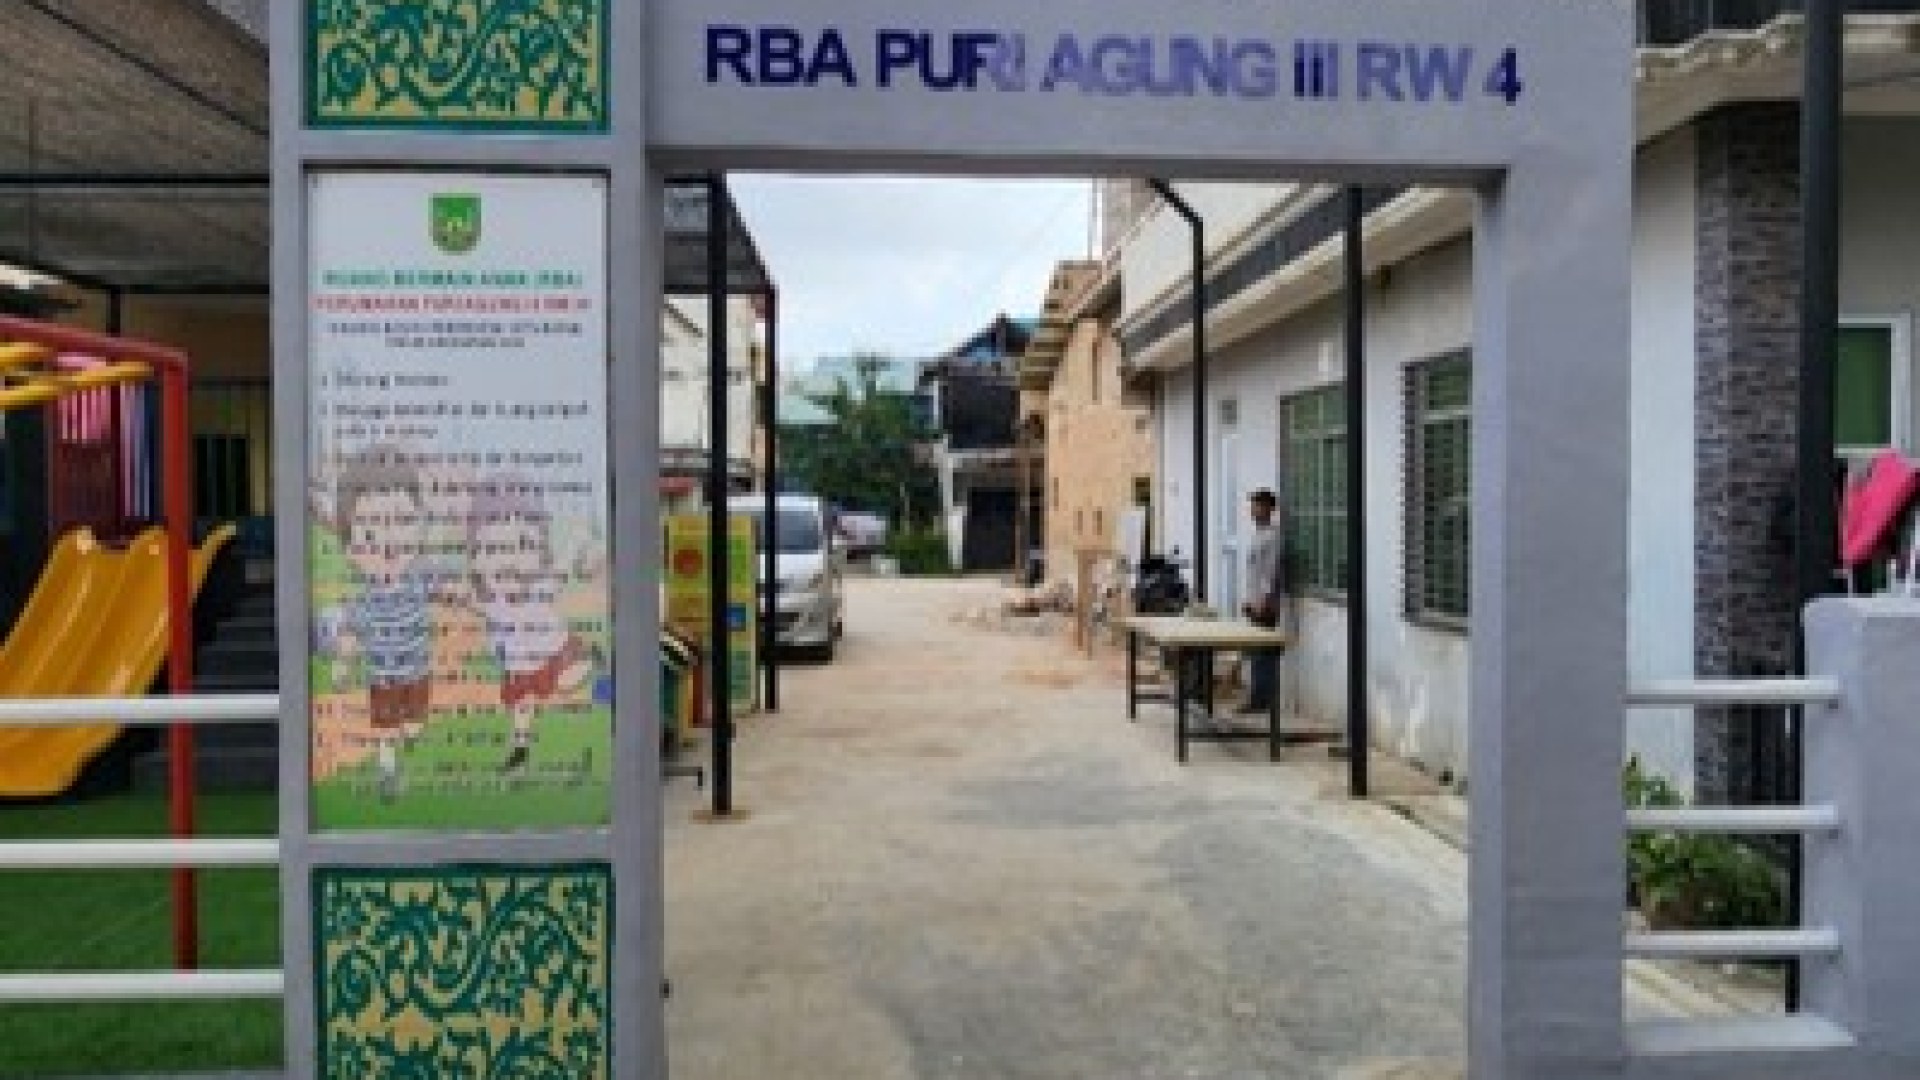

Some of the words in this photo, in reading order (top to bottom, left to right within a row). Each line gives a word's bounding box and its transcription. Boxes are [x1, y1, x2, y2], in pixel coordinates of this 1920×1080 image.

[705, 26, 857, 87] RBA
[875, 28, 1026, 92] PURI
[1039, 33, 1277, 97] AGUNG
[1356, 42, 1474, 102] RW
[1482, 47, 1524, 105] 4
